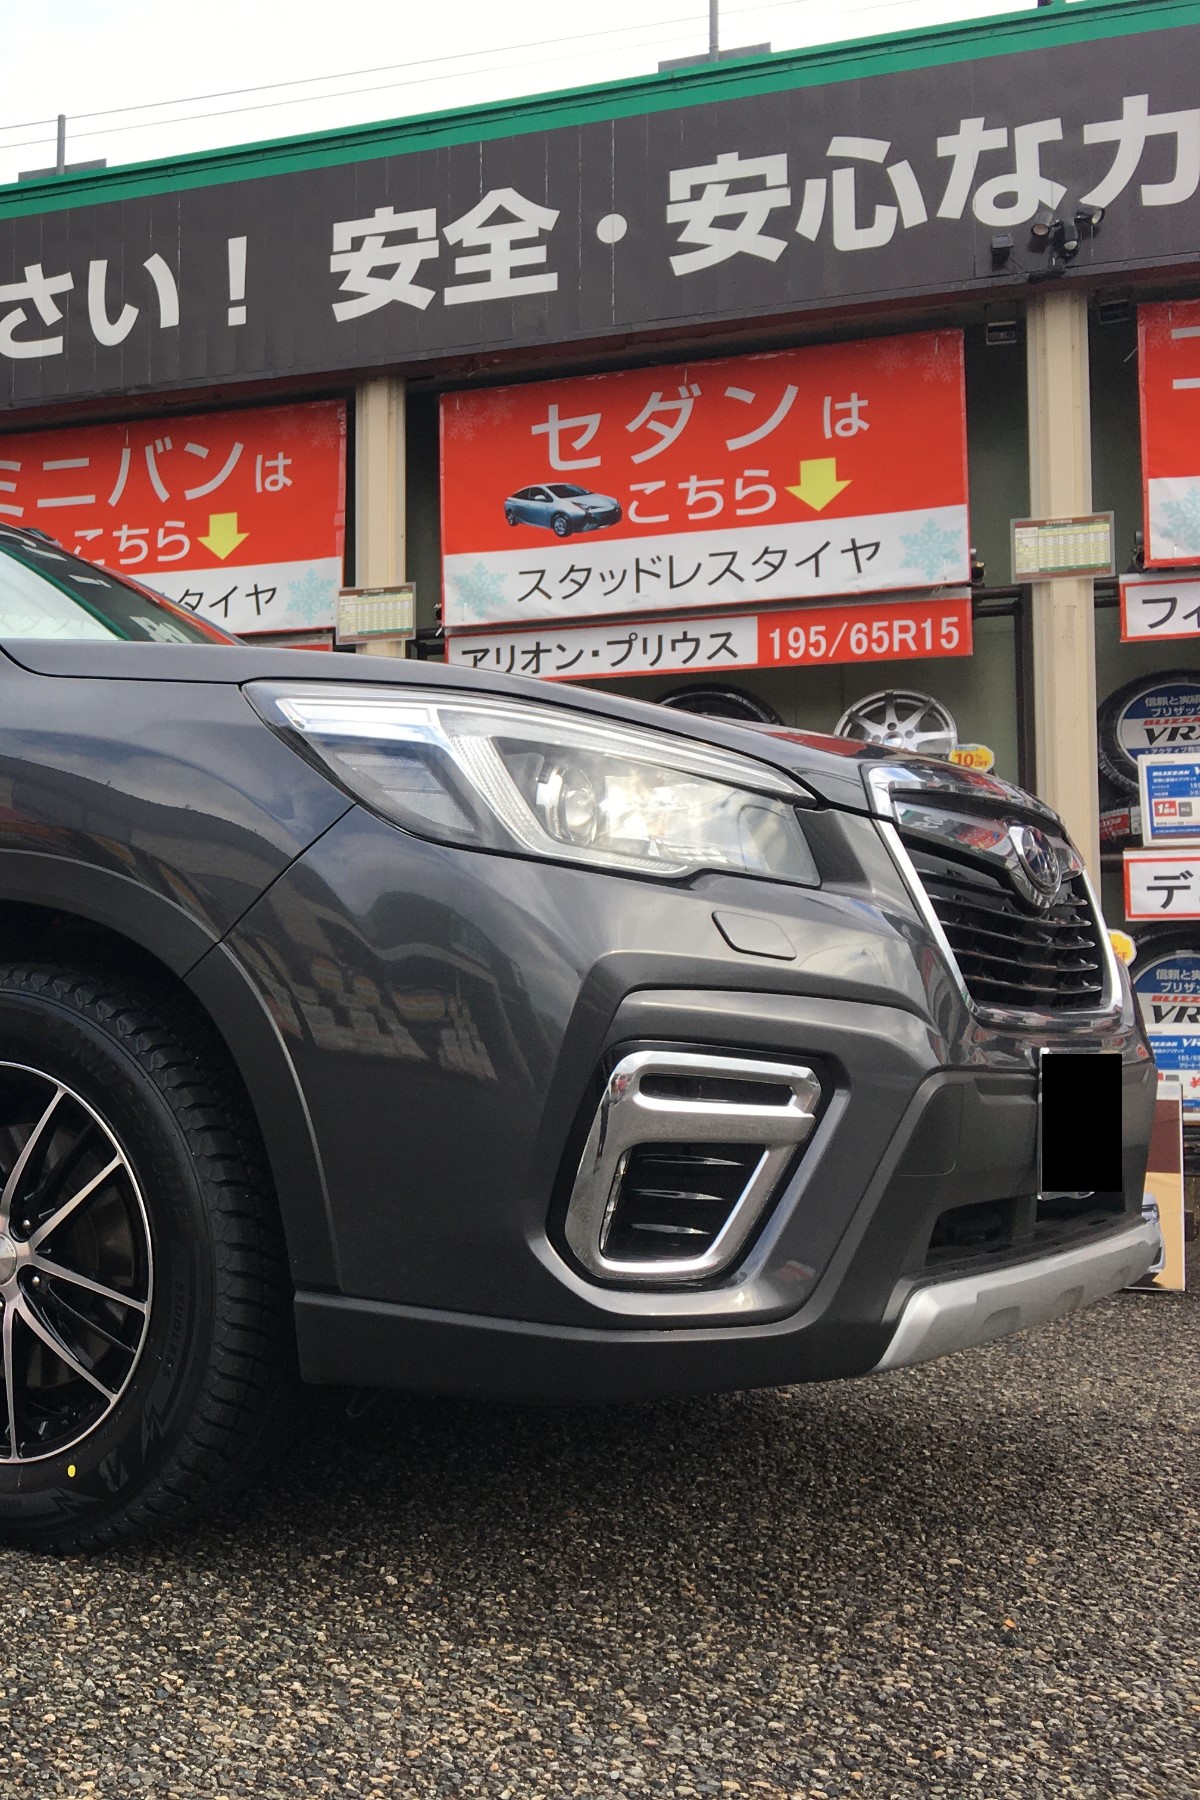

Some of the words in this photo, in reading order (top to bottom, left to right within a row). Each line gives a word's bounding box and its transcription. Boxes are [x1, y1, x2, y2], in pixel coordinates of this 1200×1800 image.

[330, 92, 1200, 323] 安全・安心なカ
[531, 384, 871, 471] セダンは
[628, 468, 778, 524] こちら
[73, 520, 191, 566] こちら
[517, 537, 882, 603] スタッドレスタイヤ
[461, 630, 739, 675] アリオン・プリウス
[769, 616, 960, 660] 195/65R15
[1144, 725, 1200, 746] VR
